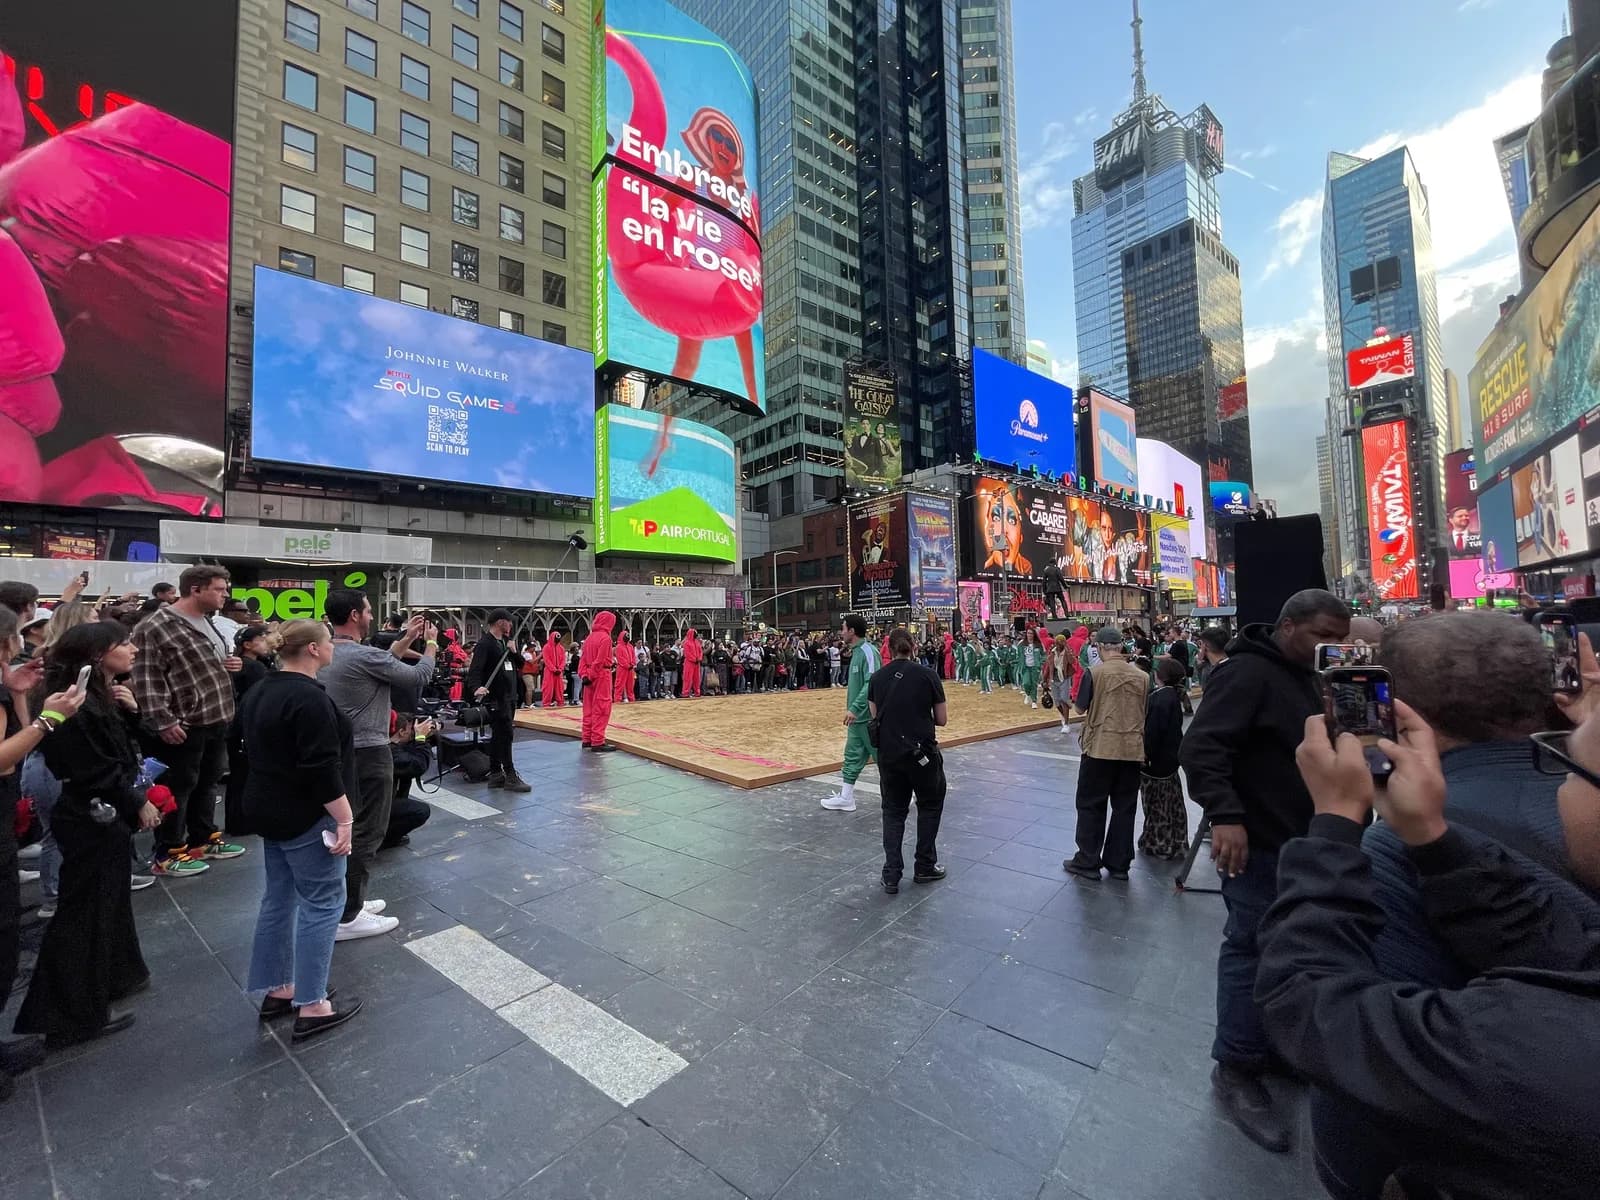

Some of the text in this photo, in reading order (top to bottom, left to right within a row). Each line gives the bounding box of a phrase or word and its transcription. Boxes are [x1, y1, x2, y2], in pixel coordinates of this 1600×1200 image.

[622, 123, 752, 218] Embrace
[622, 217, 664, 250] en
[677, 206, 723, 243] vie
[595, 179, 604, 357] Embrace Portugal
[385, 346, 509, 382] JOHNNIE WALKER
[1359, 349, 1400, 364] TAIWAN
[373, 378, 441, 398] SQUID
[446, 391, 504, 410] GAME
[1479, 341, 1529, 422] RESCUE
[848, 385, 864, 400] THE
[866, 391, 894, 405] GREAT
[854, 400, 890, 415] GATSBY
[1010, 420, 1049, 443] Paramount+
[426, 441, 470, 457] SCAN TO PLAY
[1015, 460, 1073, 488] 1540
[629, 518, 658, 538] TAP
[1030, 510, 1067, 528] CABARET
[285, 533, 332, 552] pelé
